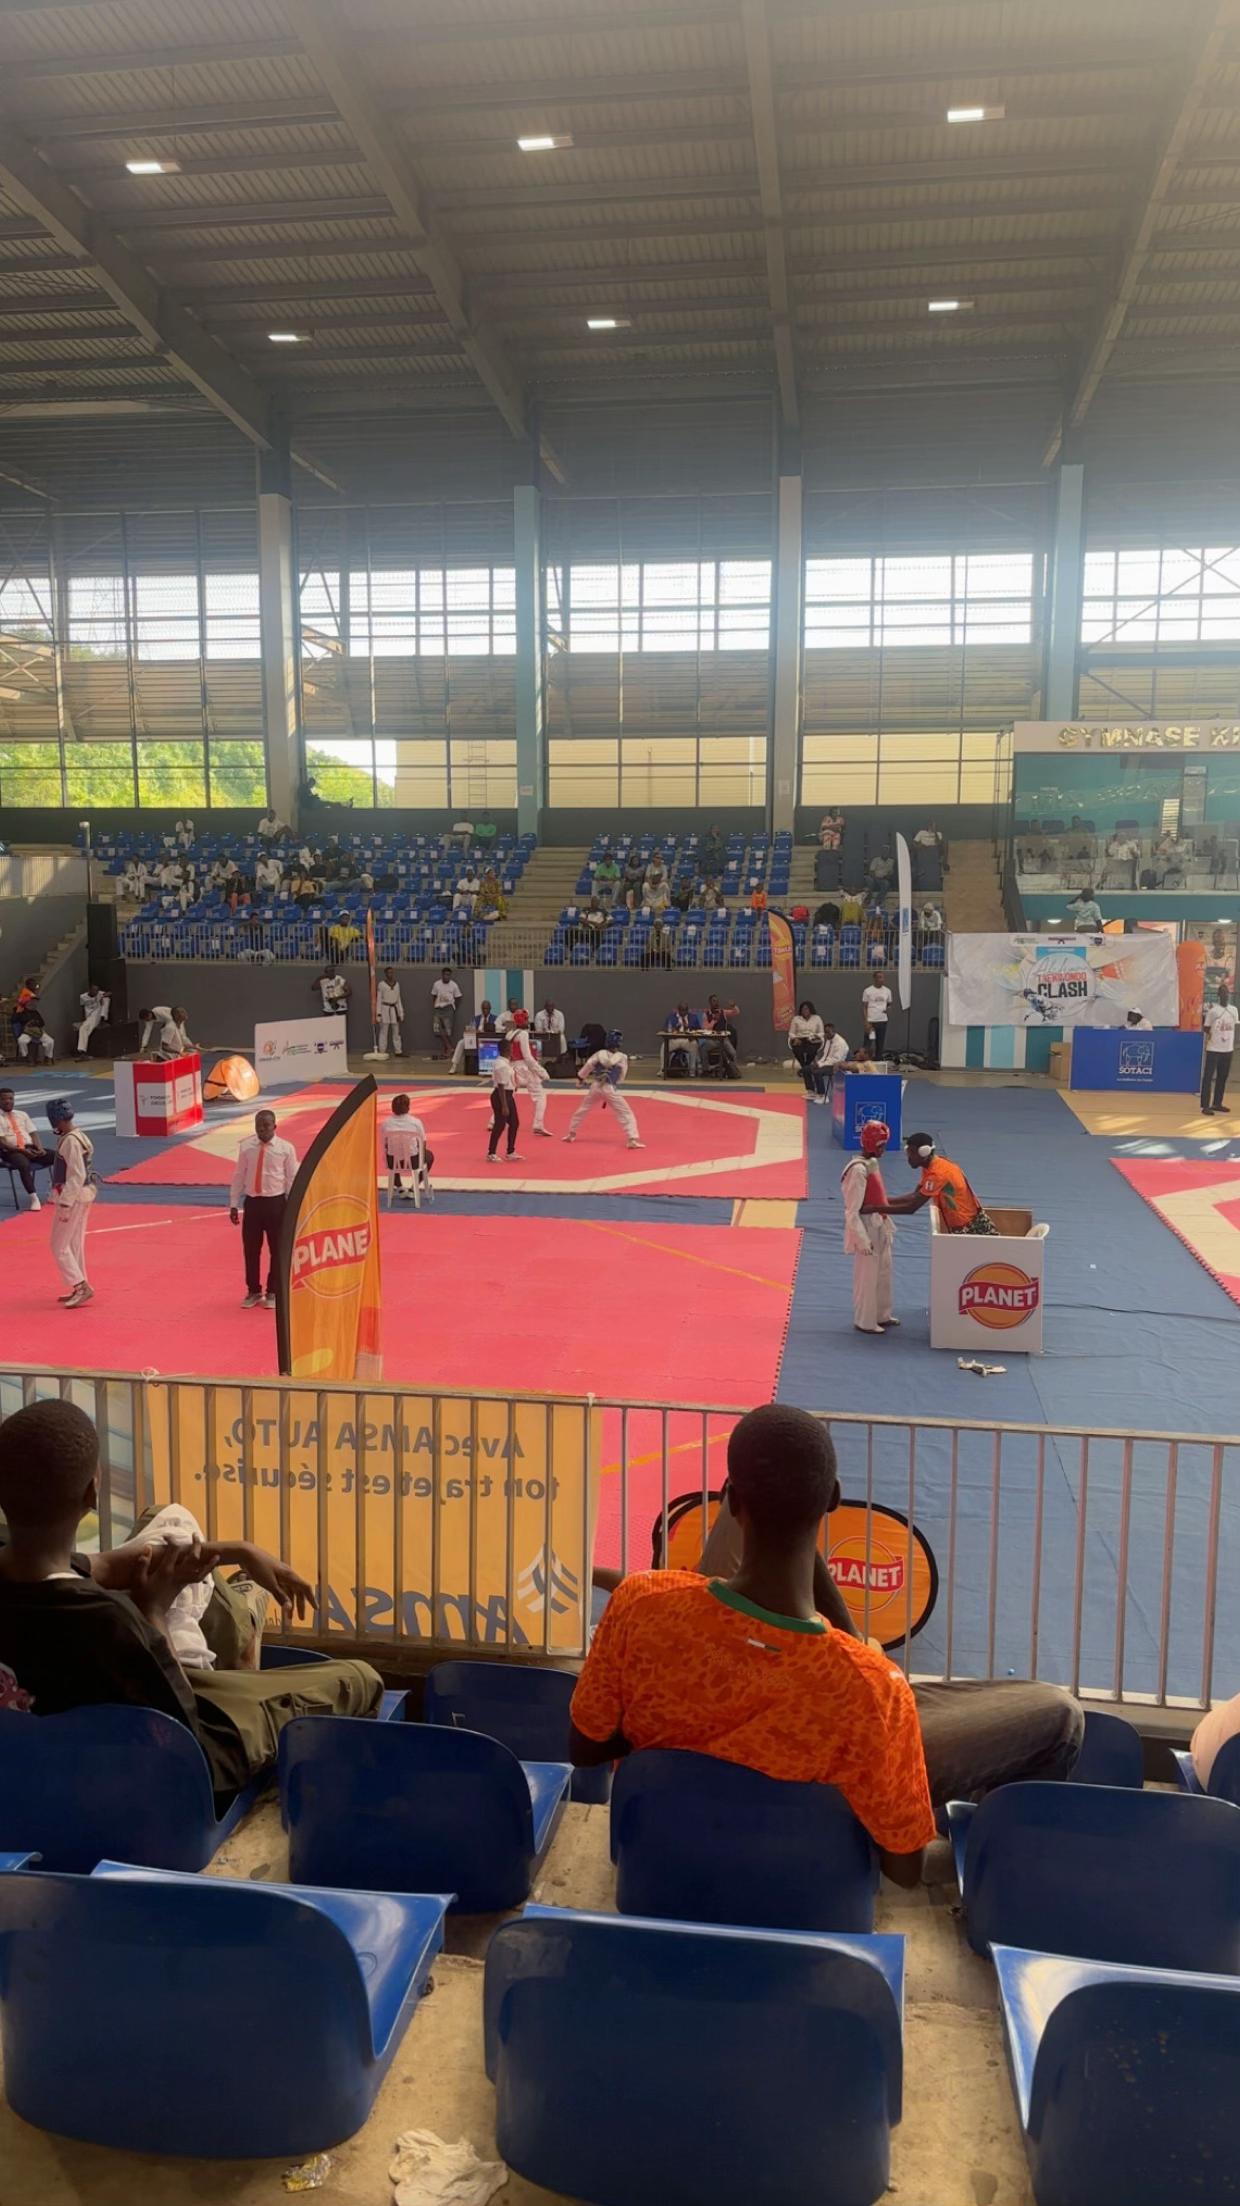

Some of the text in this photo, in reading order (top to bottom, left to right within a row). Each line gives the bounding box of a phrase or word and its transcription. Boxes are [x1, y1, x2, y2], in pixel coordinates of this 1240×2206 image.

[1057, 727, 1200, 747] GYMNASE
[1037, 980, 1088, 998] CLASH
[961, 1286, 1037, 1307] PLANET
[827, 1562, 901, 1587] PLANET
